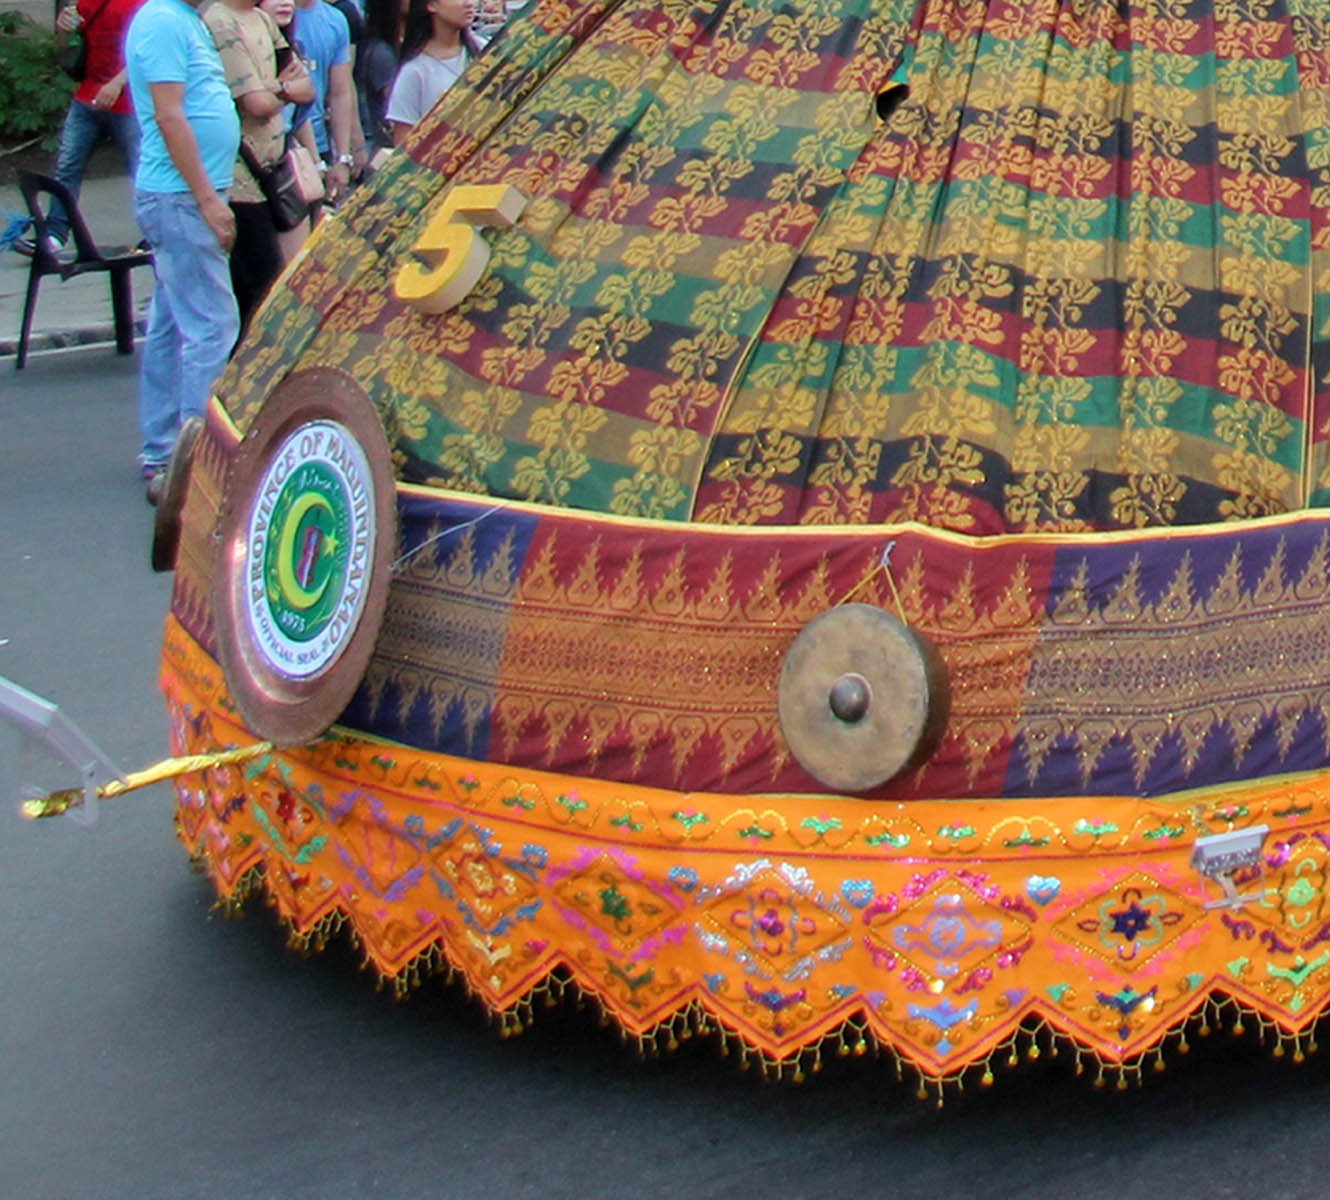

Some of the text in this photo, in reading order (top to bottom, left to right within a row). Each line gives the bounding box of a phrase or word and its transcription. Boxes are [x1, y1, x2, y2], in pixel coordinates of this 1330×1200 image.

[395, 184, 522, 308] 5
[250, 448, 295, 605] PROVINCE
[300, 430, 325, 460] OF
[326, 432, 370, 646] MAGUINDANAO
[259, 616, 321, 666] OFFICIAL SEAL
